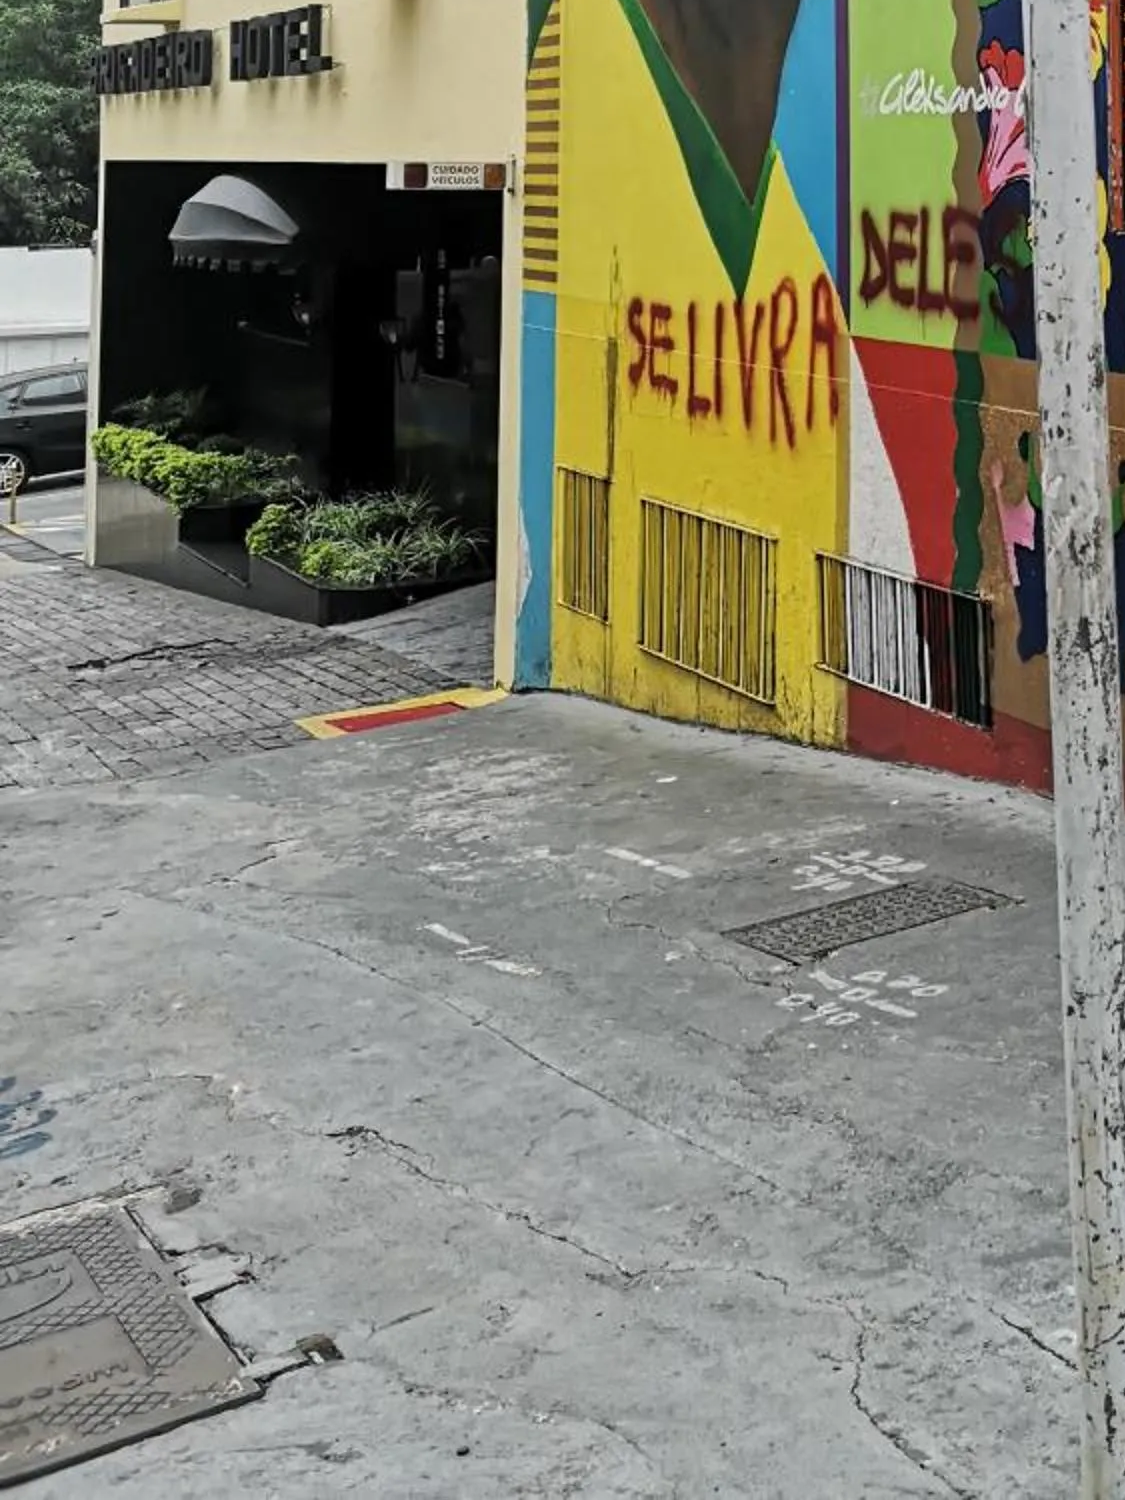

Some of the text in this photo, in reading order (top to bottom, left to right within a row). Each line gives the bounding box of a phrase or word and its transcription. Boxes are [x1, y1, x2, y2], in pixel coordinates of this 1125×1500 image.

[229, 3, 334, 82] HOTEL
[431, 164, 480, 175] CUIDADO
[626, 269, 840, 451] SE LIVRA
